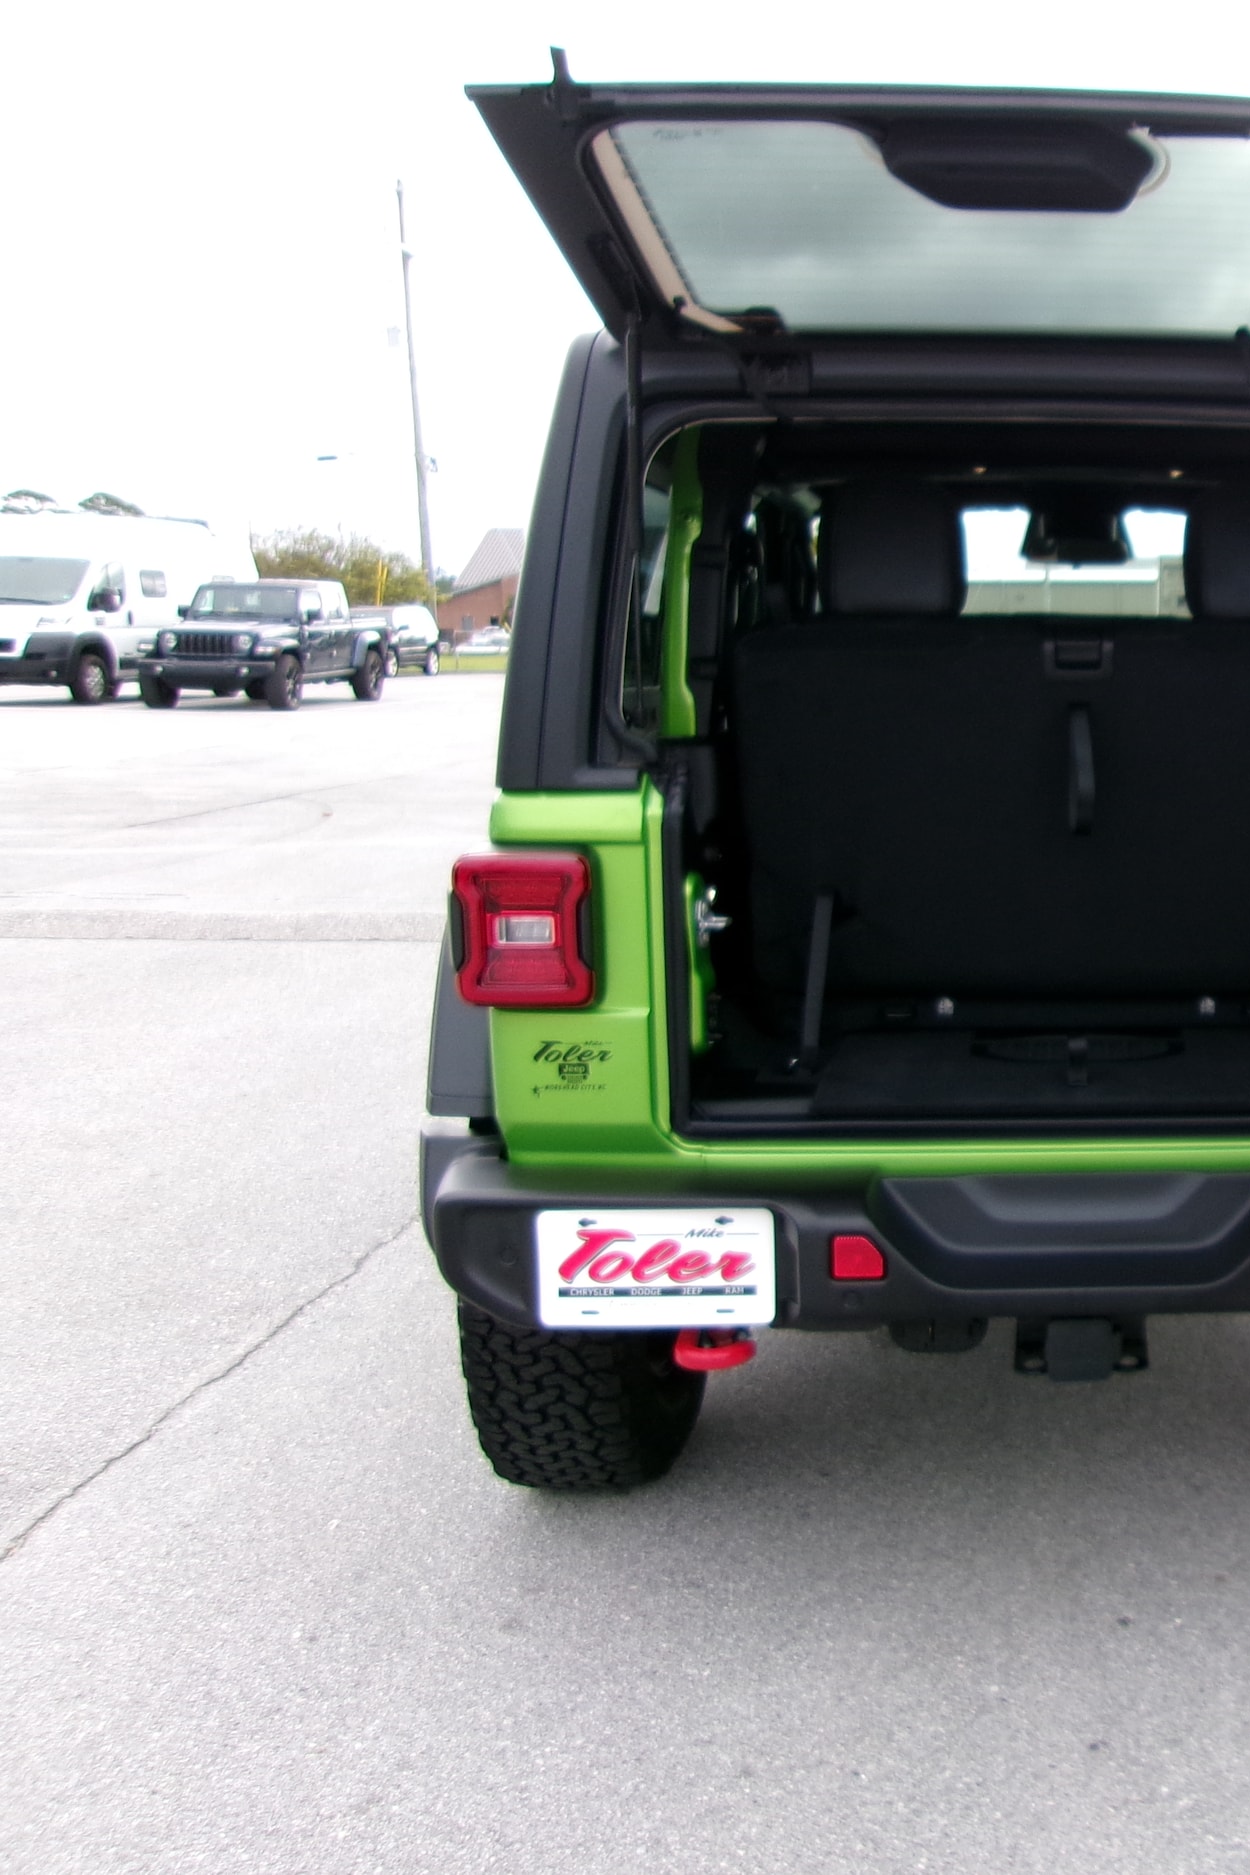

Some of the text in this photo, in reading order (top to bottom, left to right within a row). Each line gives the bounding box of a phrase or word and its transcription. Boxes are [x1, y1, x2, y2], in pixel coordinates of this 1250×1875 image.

[533, 1040, 613, 1062] Toler
[563, 1064, 586, 1074] Jeep
[685, 1228, 724, 1239] Mike
[558, 1229, 756, 1284] Toler
[570, 1285, 745, 1297] CHRYSLER DODGE JEEP RAM
